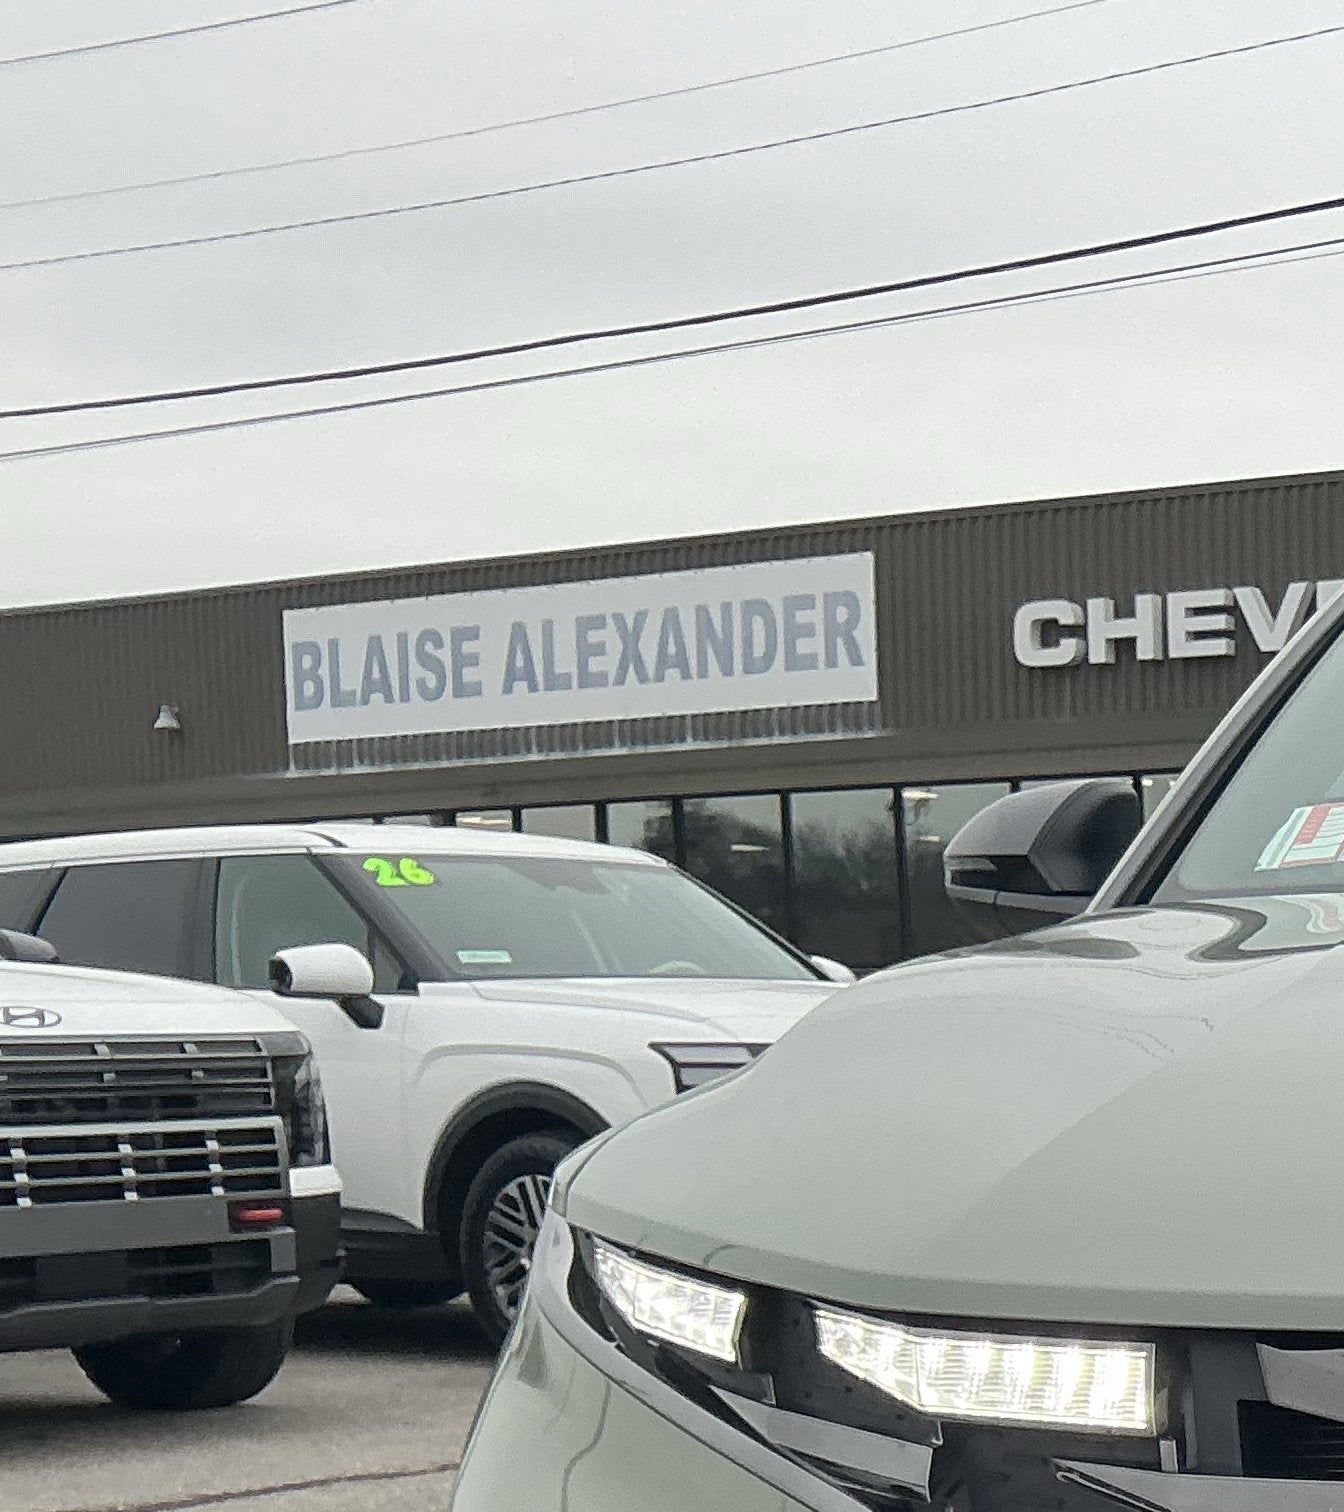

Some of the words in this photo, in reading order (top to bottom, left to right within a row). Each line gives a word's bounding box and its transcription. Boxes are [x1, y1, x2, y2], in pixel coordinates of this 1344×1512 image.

[291, 623, 483, 712] BLAISE
[501, 590, 865, 695] ALEXANDER
[361, 856, 436, 888] 26
